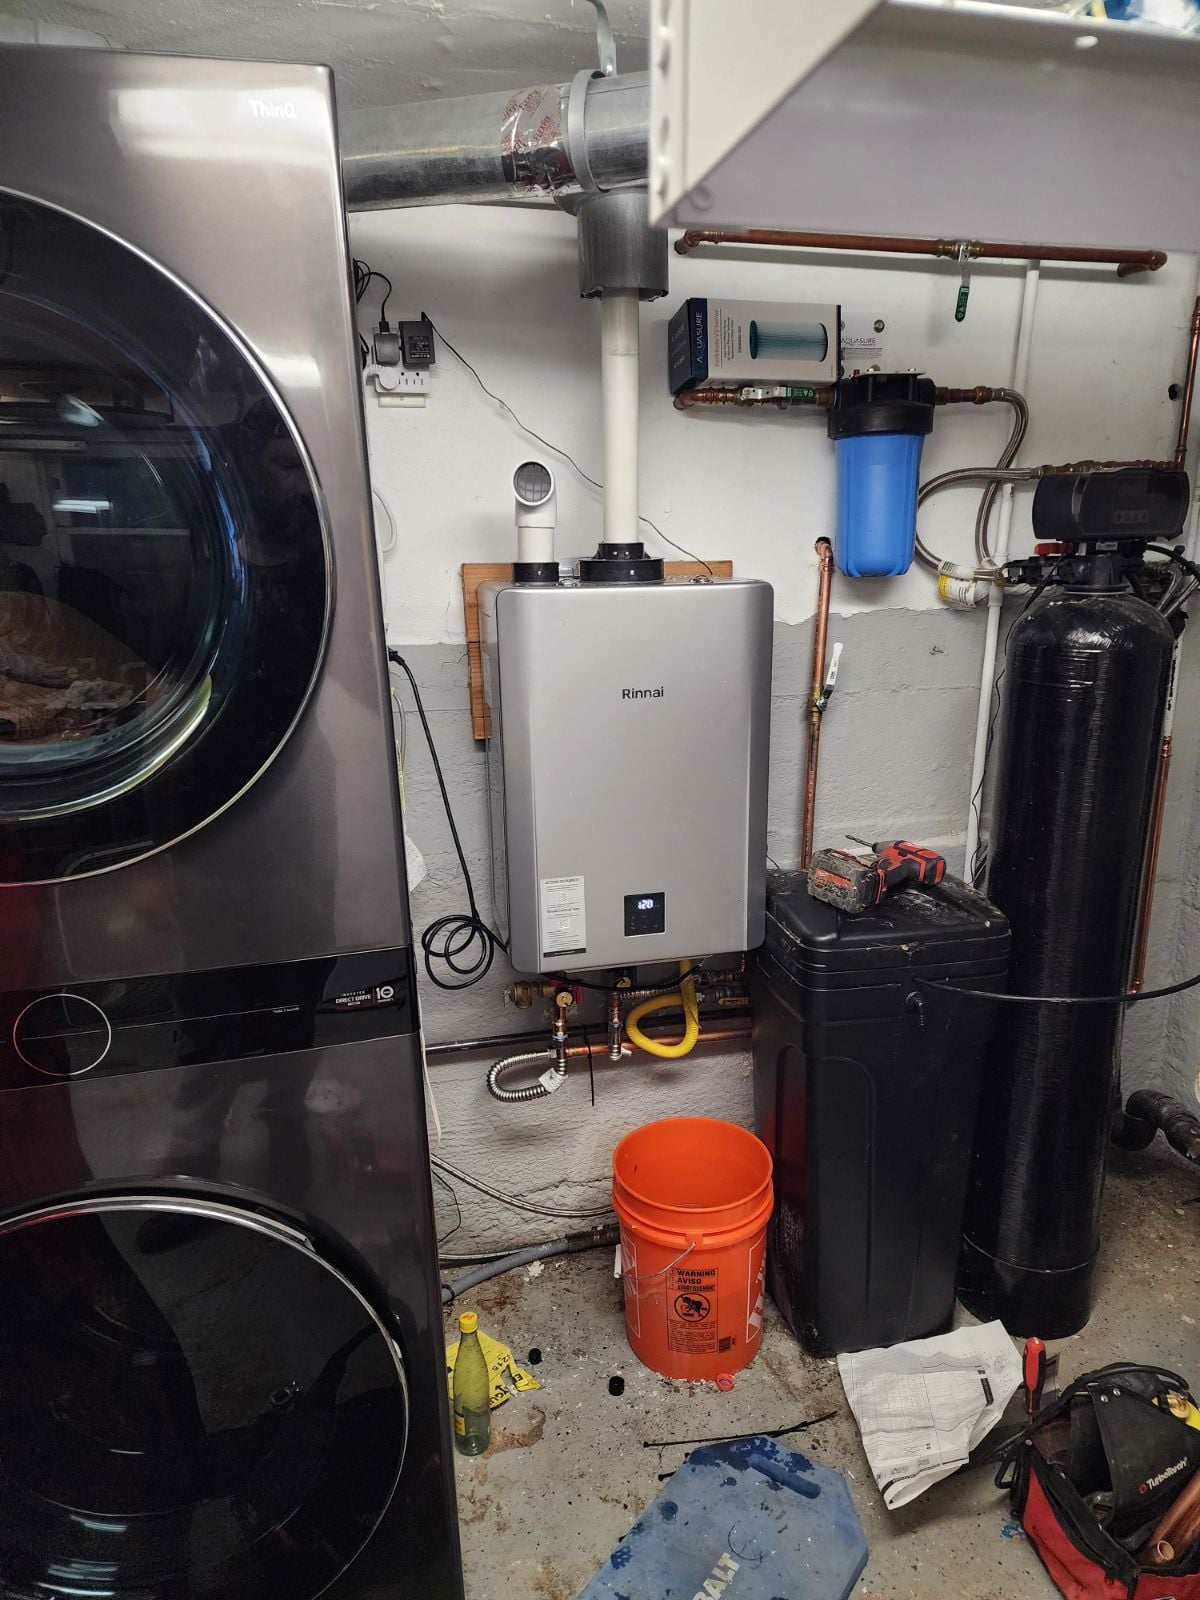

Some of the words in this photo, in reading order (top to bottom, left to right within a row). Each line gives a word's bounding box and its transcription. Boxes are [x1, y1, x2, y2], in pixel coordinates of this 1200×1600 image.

[247, 99, 298, 120] ThinQ
[696, 311, 705, 363] AQUASURE
[622, 686, 664, 699] Rinnai
[638, 899, 653, 909] 120
[335, 996, 355, 1004] DIRECT
[677, 1269, 716, 1277] WARNING
[677, 1277, 702, 1285] AVISO
